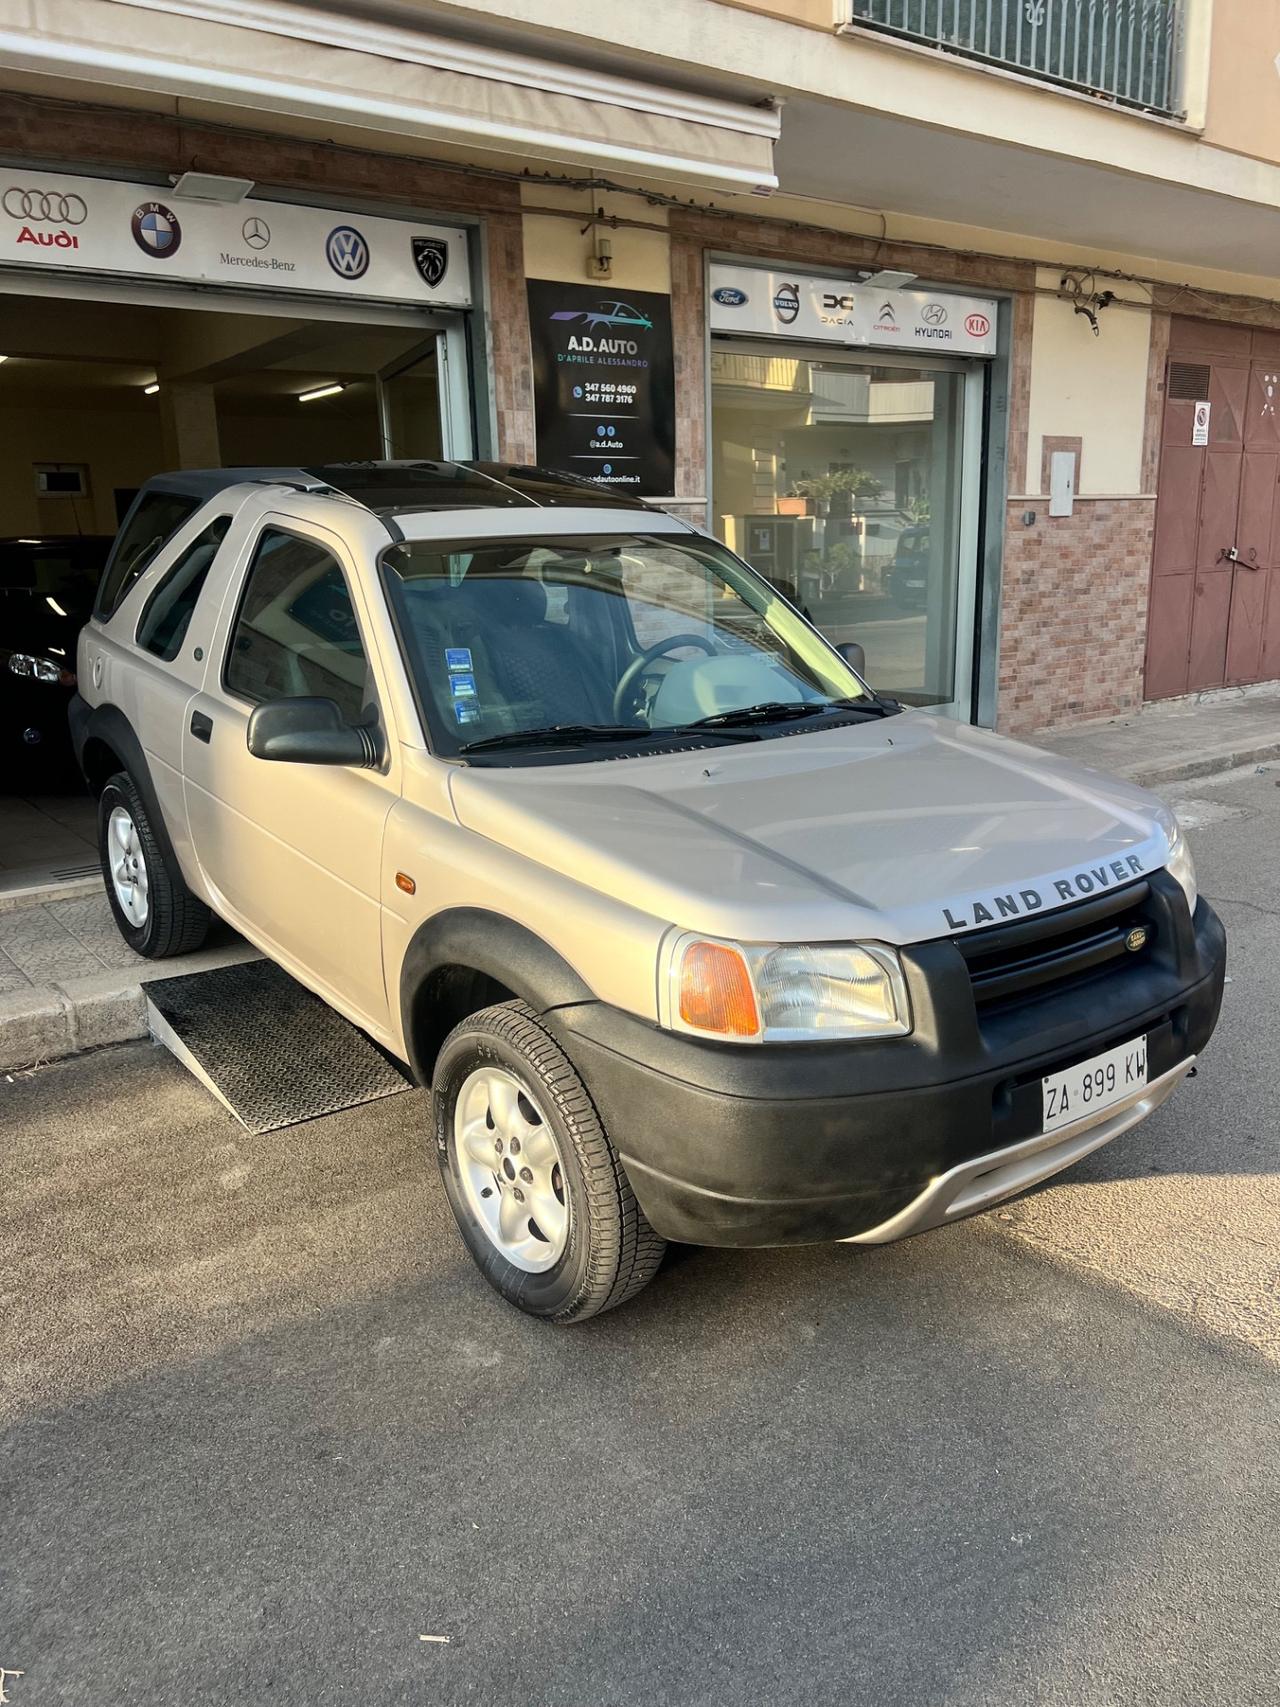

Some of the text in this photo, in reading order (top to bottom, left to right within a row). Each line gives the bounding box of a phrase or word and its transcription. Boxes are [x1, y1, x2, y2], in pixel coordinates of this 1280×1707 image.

[135, 203, 176, 223] BMW
[16, 226, 80, 249] Audi
[219, 252, 297, 272] Mercedes-Benz
[719, 290, 740, 304] Ford
[774, 299, 798, 309] VOLVO
[820, 316, 854, 326] DACIA
[968, 319, 986, 332] KIA
[914, 327, 952, 340] HYUNDAI
[598, 338, 638, 355] AUTO
[557, 354, 648, 368] D'APRILE ALESSANDRO
[584, 383, 637, 394] 347 560 4960
[585, 393, 633, 404] 347 787 3176
[590, 475, 641, 484] adautoonline.it
[942, 853, 1145, 930] LAND ROVER
[1046, 1048, 1146, 1120] ZA 899 KW
